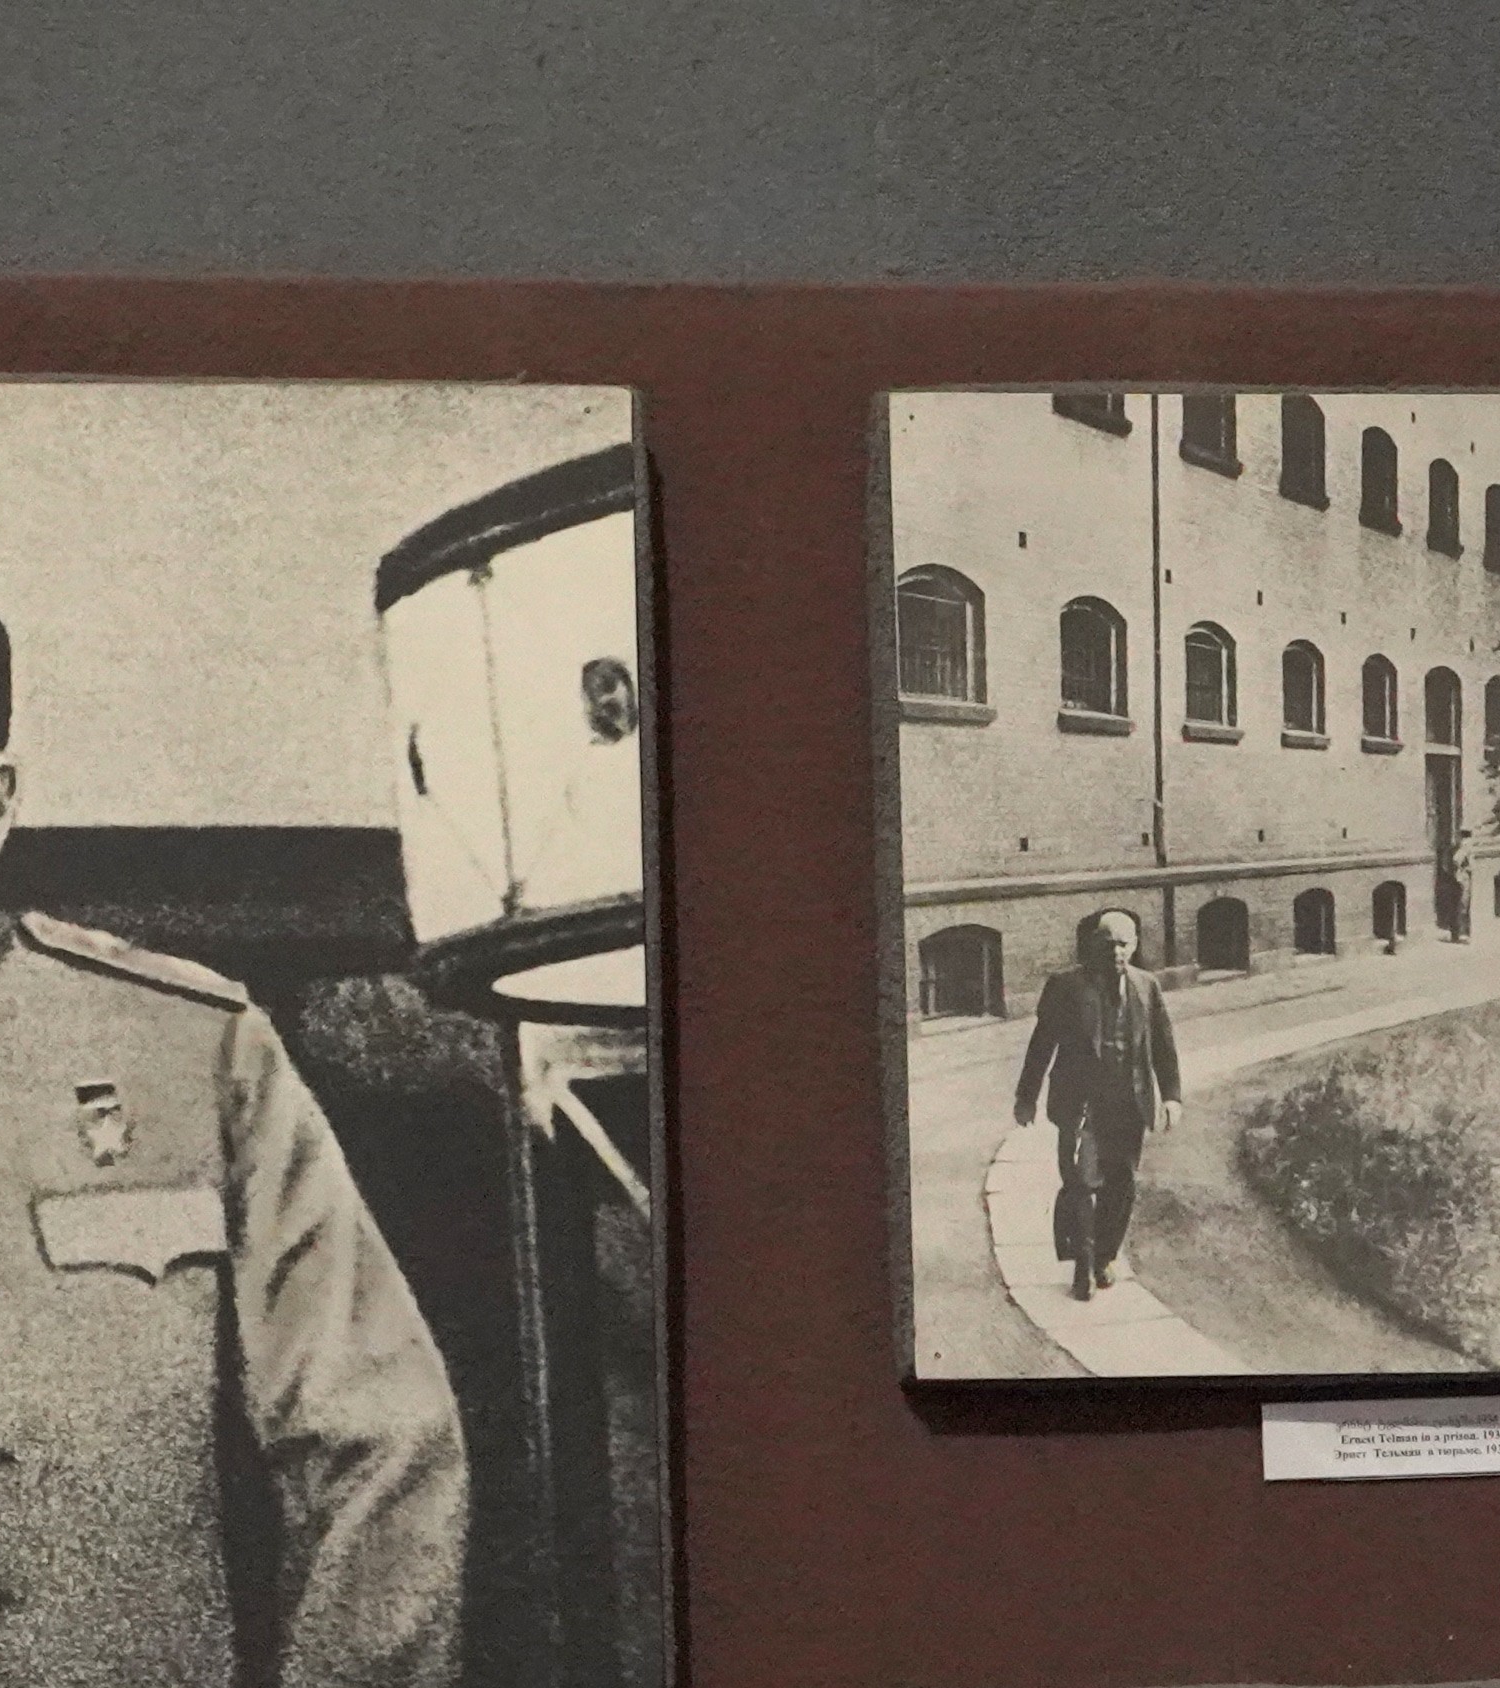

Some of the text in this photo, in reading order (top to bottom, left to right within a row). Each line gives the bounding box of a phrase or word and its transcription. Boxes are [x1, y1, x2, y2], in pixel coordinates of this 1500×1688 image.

[1341, 1434, 1376, 1445] Ernest
[1378, 1433, 1417, 1443] Telman
[1421, 1432, 1430, 1441] in
[1434, 1434, 1440, 1442] a
